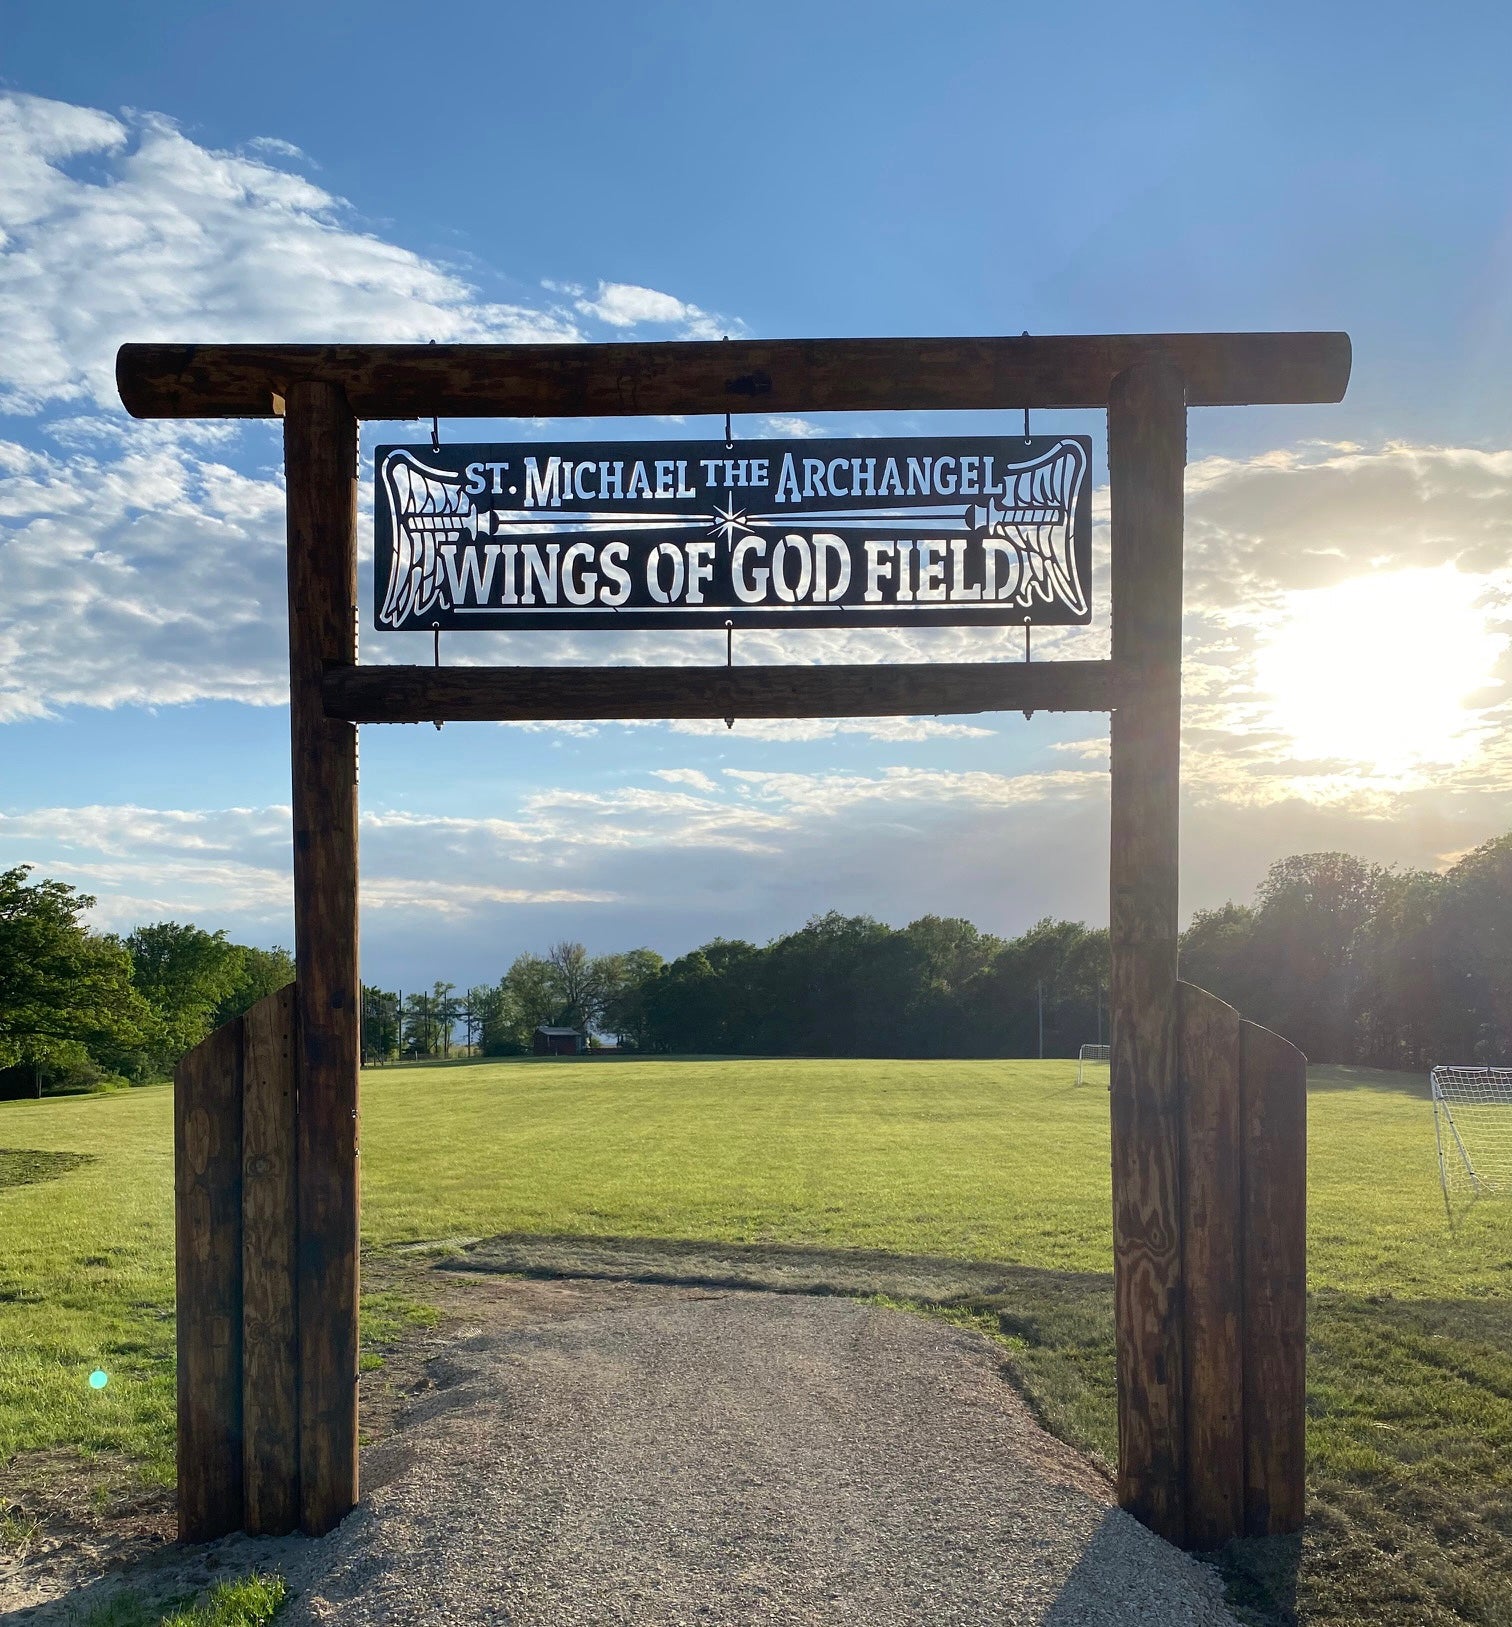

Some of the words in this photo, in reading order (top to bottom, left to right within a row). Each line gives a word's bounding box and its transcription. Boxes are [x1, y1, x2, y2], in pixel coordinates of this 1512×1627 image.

[465, 462, 517, 495] ST.
[523, 456, 696, 507] MICHAEL
[699, 459, 770, 487] THE
[774, 452, 1003, 503] ARCHANGEL
[440, 541, 632, 606] WINGS
[646, 542, 716, 604] OF
[731, 533, 851, 604] GOD
[863, 538, 1020, 602] FIELD
